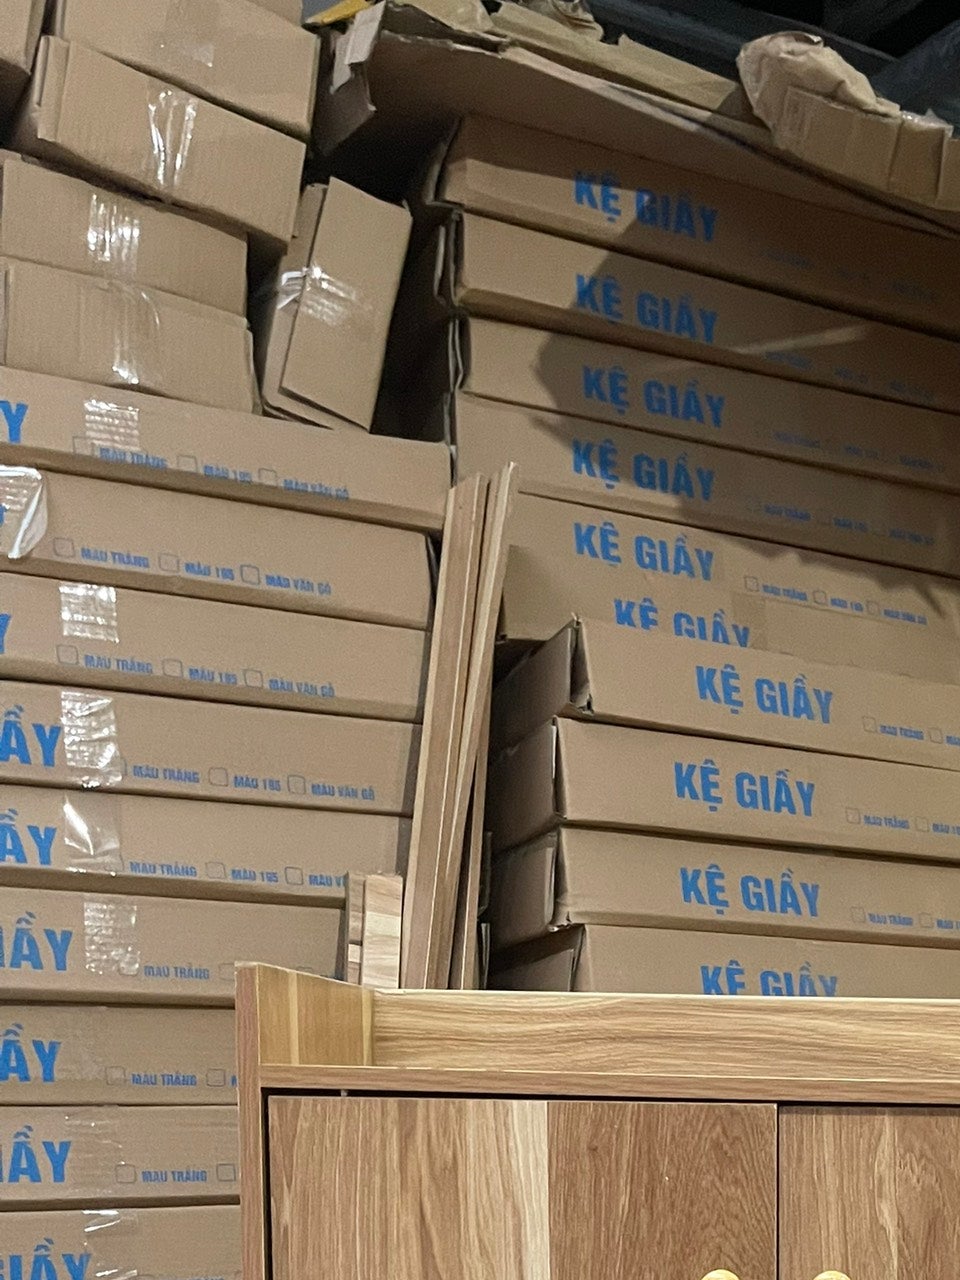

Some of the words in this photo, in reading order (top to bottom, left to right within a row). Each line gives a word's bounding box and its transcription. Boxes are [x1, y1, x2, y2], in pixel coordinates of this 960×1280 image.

[574, 171, 622, 223] KỆ
[576, 273, 623, 325] KỆ
[582, 364, 629, 414] KỆ
[572, 438, 620, 489] KỆ
[696, 664, 744, 714] KỆ
[674, 759, 723, 812] KỆ
[680, 864, 729, 914] KỆ
